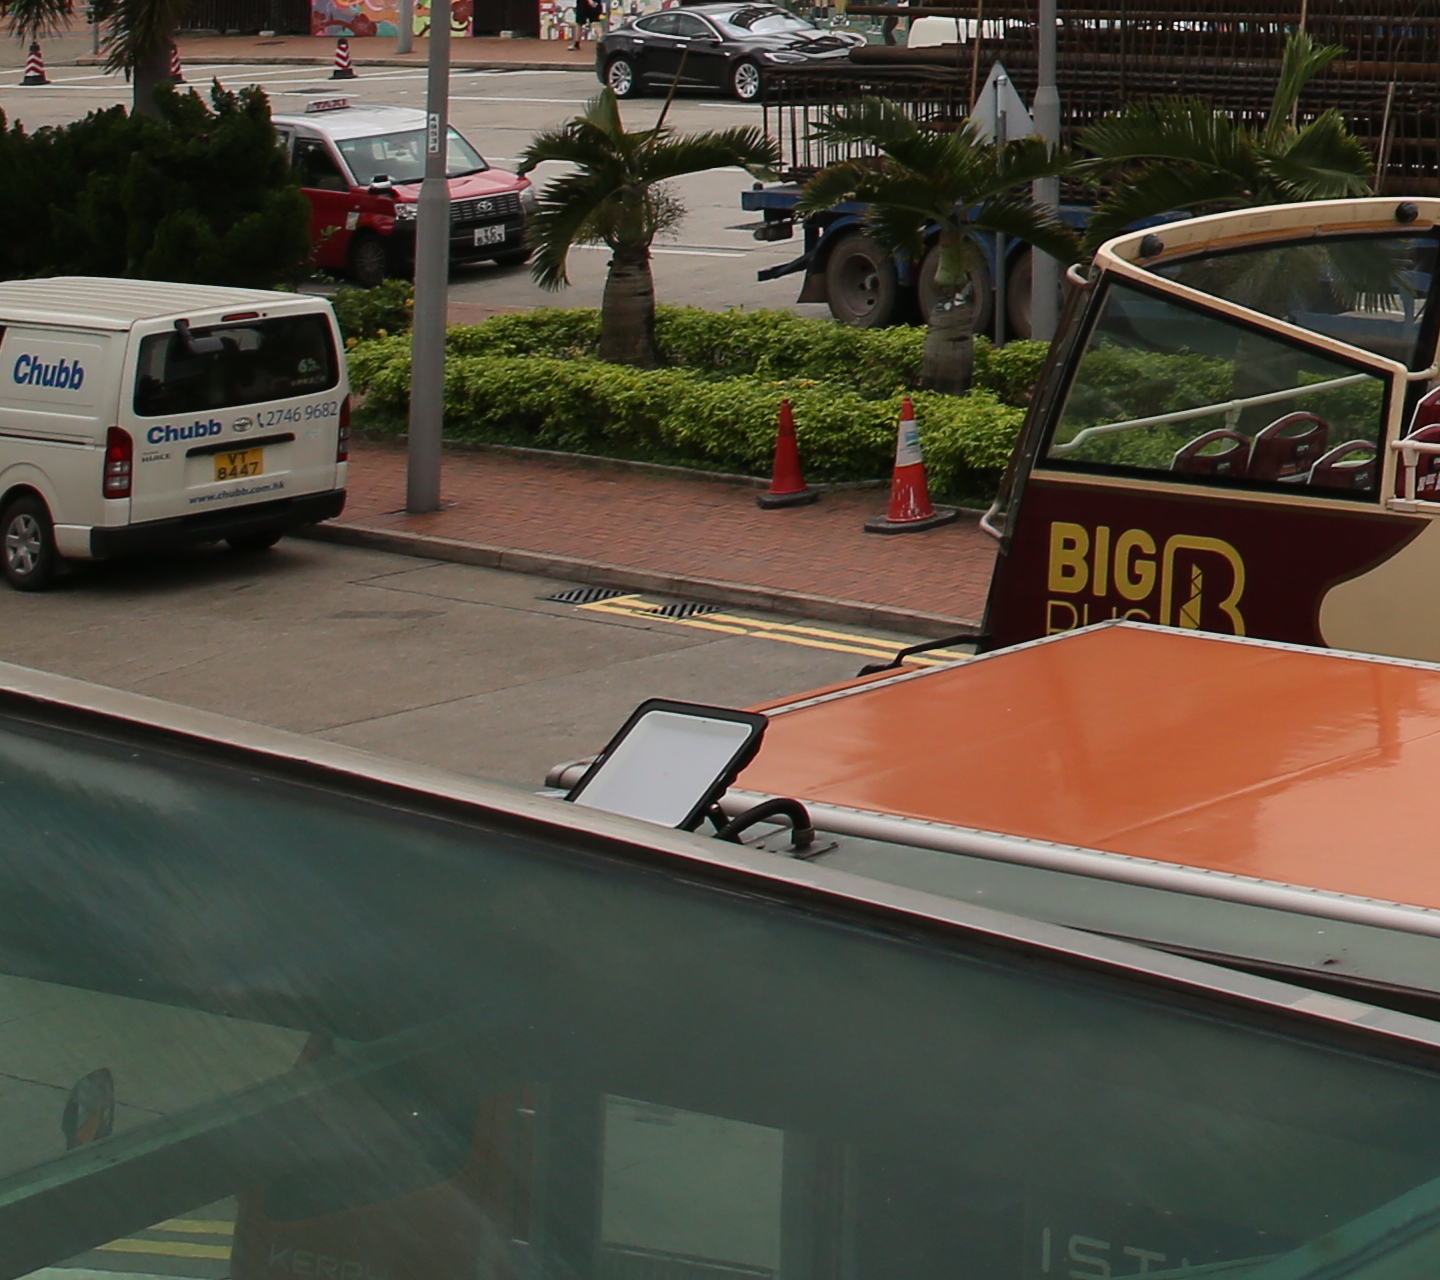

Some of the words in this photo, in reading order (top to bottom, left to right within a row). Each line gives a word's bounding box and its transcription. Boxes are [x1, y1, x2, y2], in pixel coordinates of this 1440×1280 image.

[316, 99, 347, 110] TAXI
[13, 354, 85, 390] Chubb
[147, 419, 222, 444] Chubb
[266, 407, 301, 426] 2746
[305, 401, 338, 420] 9682
[228, 451, 249, 465] VT
[217, 462, 259, 480] 8447
[189, 481, 285, 505] www.chubb.com.hk
[1048, 521, 1156, 601] BIG
